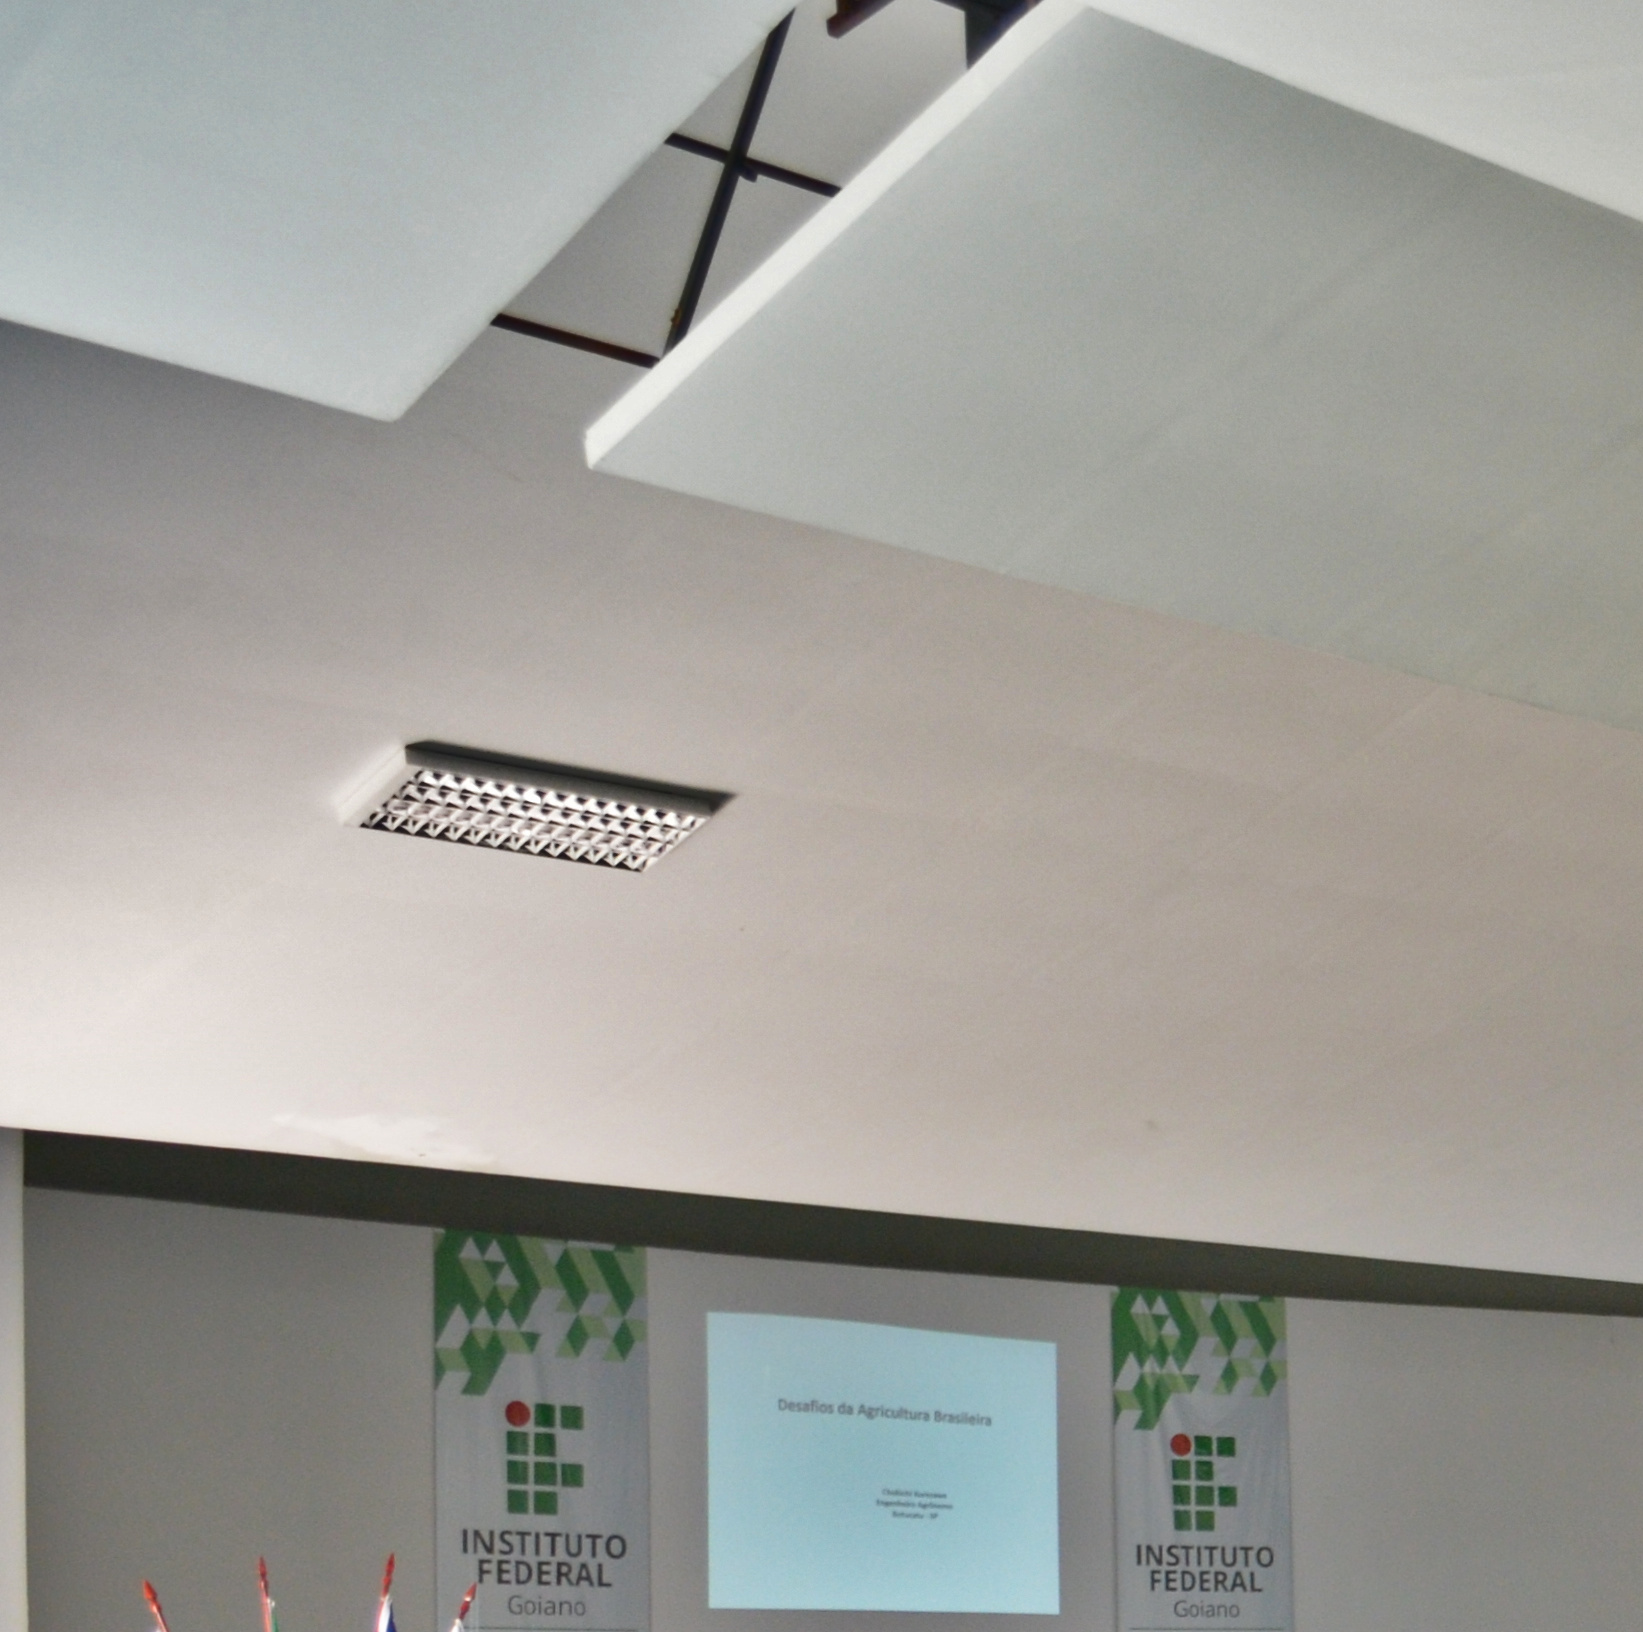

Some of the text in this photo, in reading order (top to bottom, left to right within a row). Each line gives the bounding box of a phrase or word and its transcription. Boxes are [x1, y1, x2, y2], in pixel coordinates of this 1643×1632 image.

[778, 1398, 992, 1427] Desafios da Agricultura Brasileira
[462, 1528, 628, 1560] INSTITUTO
[1136, 1544, 1275, 1568] INSTITUTO
[478, 1559, 612, 1587] FEDERAL
[1150, 1570, 1263, 1593] FEDERAL
[507, 1595, 587, 1616] Goiano
[1173, 1600, 1240, 1618] Goiano
